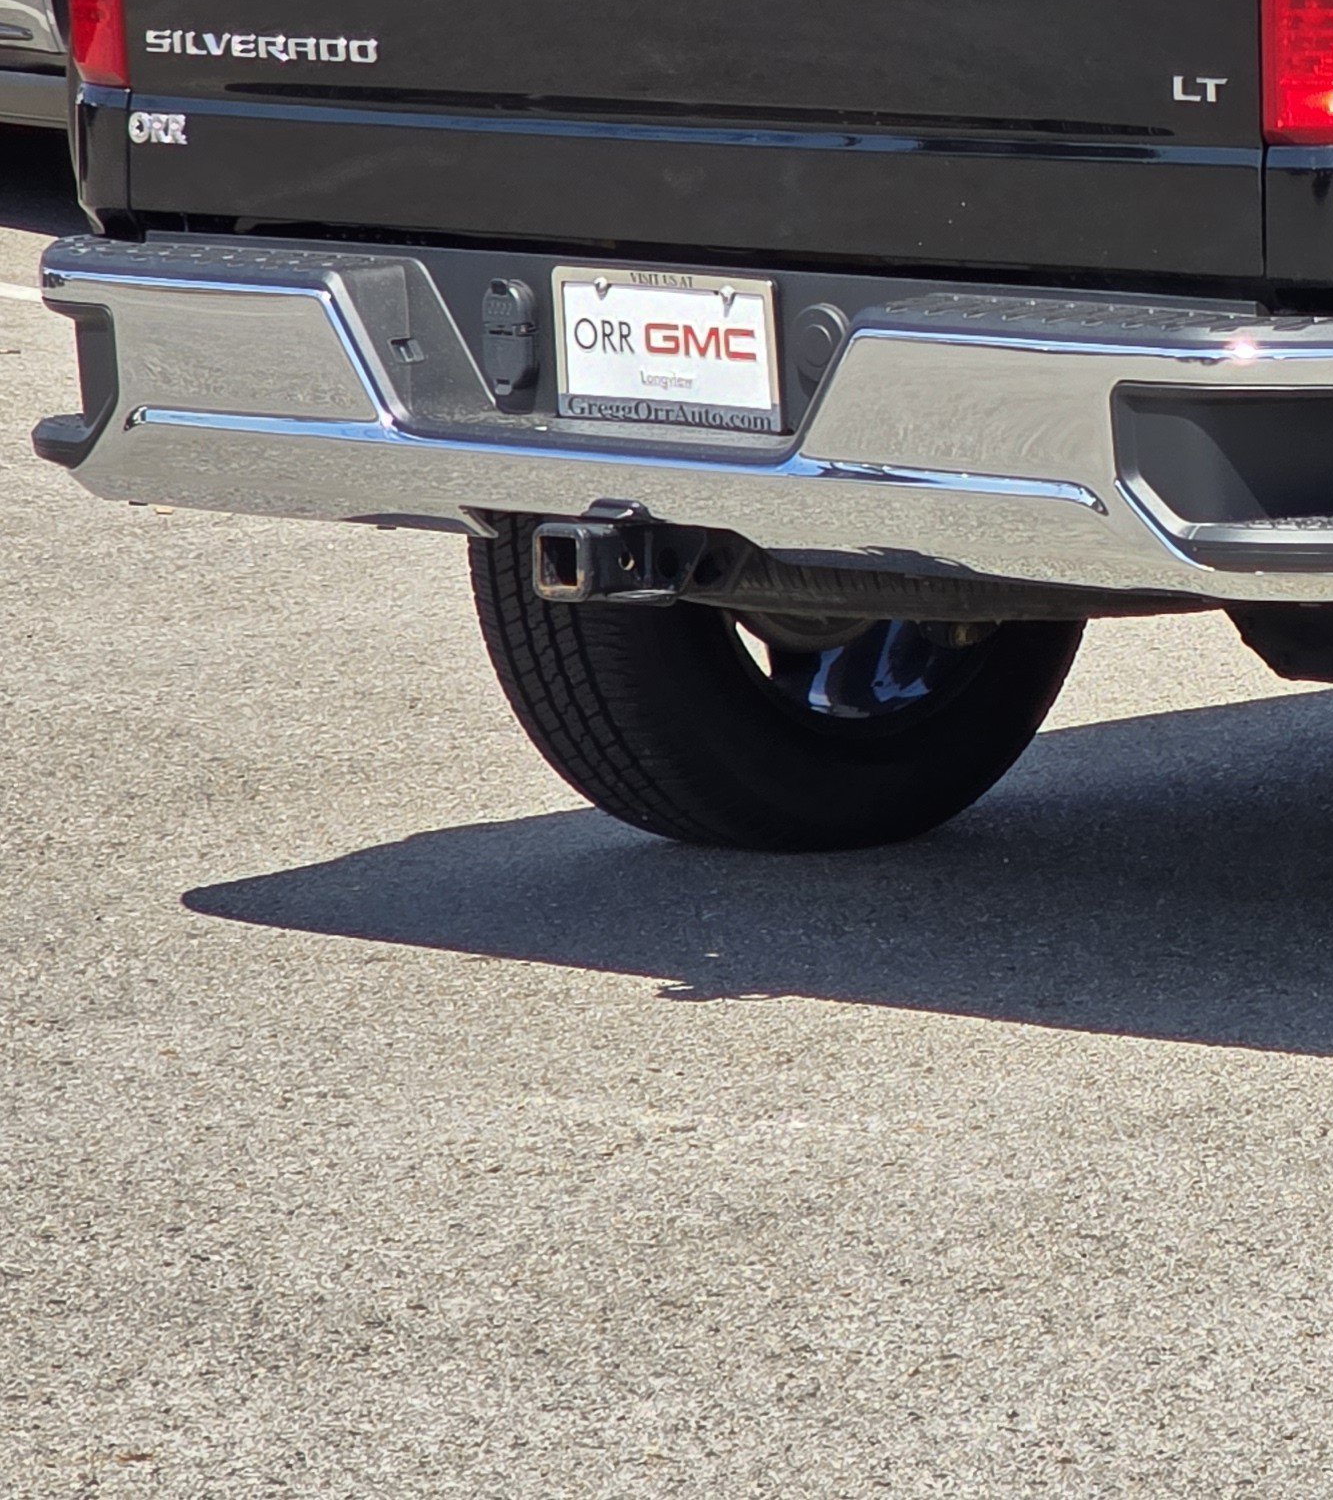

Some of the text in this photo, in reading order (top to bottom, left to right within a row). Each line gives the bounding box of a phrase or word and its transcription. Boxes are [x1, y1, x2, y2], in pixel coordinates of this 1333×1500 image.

[145, 29, 379, 64] SILVERADO
[1173, 75, 1228, 102] LT
[128, 111, 188, 145] ORR
[629, 271, 694, 288] VISIT US AT
[574, 317, 757, 362] ORR GMC
[567, 395, 772, 431] GreggOrrAuto.com
